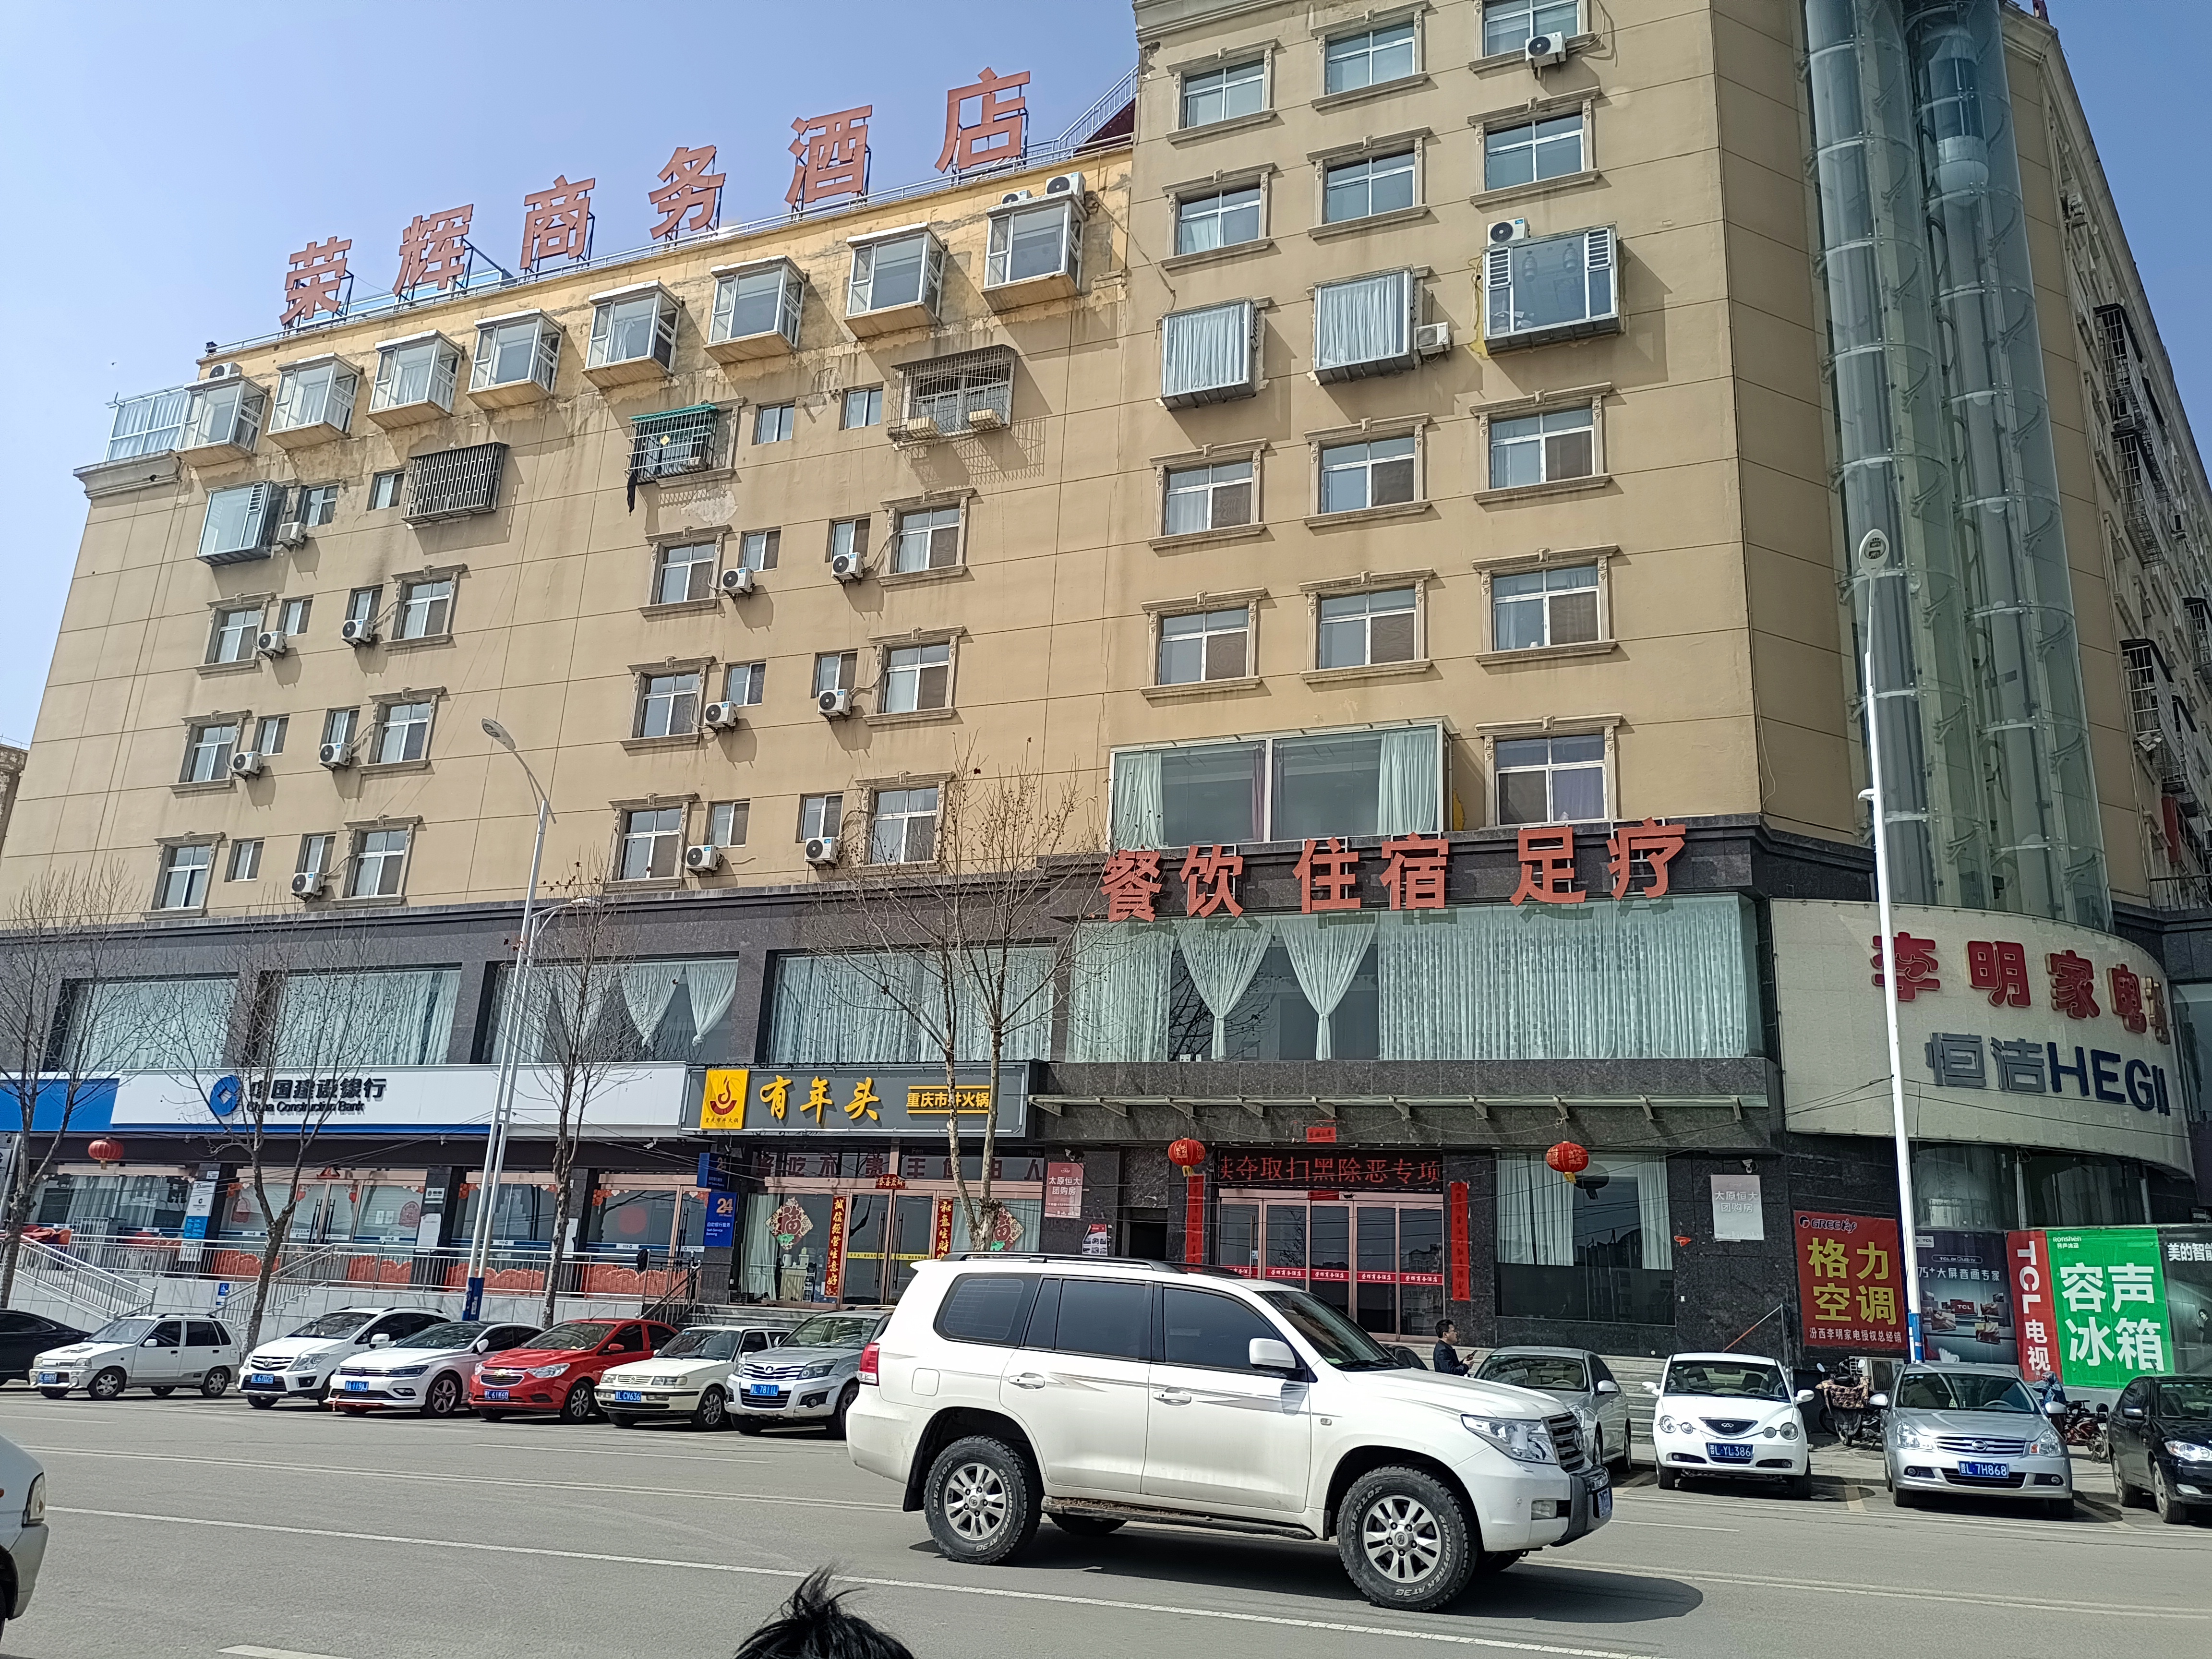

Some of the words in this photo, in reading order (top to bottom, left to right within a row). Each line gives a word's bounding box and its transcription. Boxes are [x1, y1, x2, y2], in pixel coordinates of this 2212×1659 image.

[278, 67, 1031, 326] 荣辉商务酒店
[1100, 843, 1244, 923] 餐饮
[1291, 831, 1449, 914] 住宿
[1510, 817, 1686, 907] 足疗
[1924, 1032, 2047, 1093] 恒洁
[2047, 1042, 2171, 1116] HEGII
[760, 1075, 880, 1124] 有年头
[1048, 1177, 1081, 1185] 太原恒大
[1052, 1187, 1076, 1195] 团购房
[1714, 1190, 1758, 1201] 太原恒大
[716, 1198, 733, 1214] 24
[1721, 1202, 1754, 1213] 团购房
[1811, 1219, 1841, 1230] GREE
[1807, 1237, 1889, 1280] 格力
[2017, 1240, 2041, 1314] TCL
[1813, 1283, 1897, 1325] 空调
[2060, 1262, 2155, 1313] 容声
[1809, 1327, 1902, 1343] 汾西李明家电授权总经销
[2025, 1319, 2051, 1371] 电视
[2065, 1316, 2165, 1371] 冰箱
